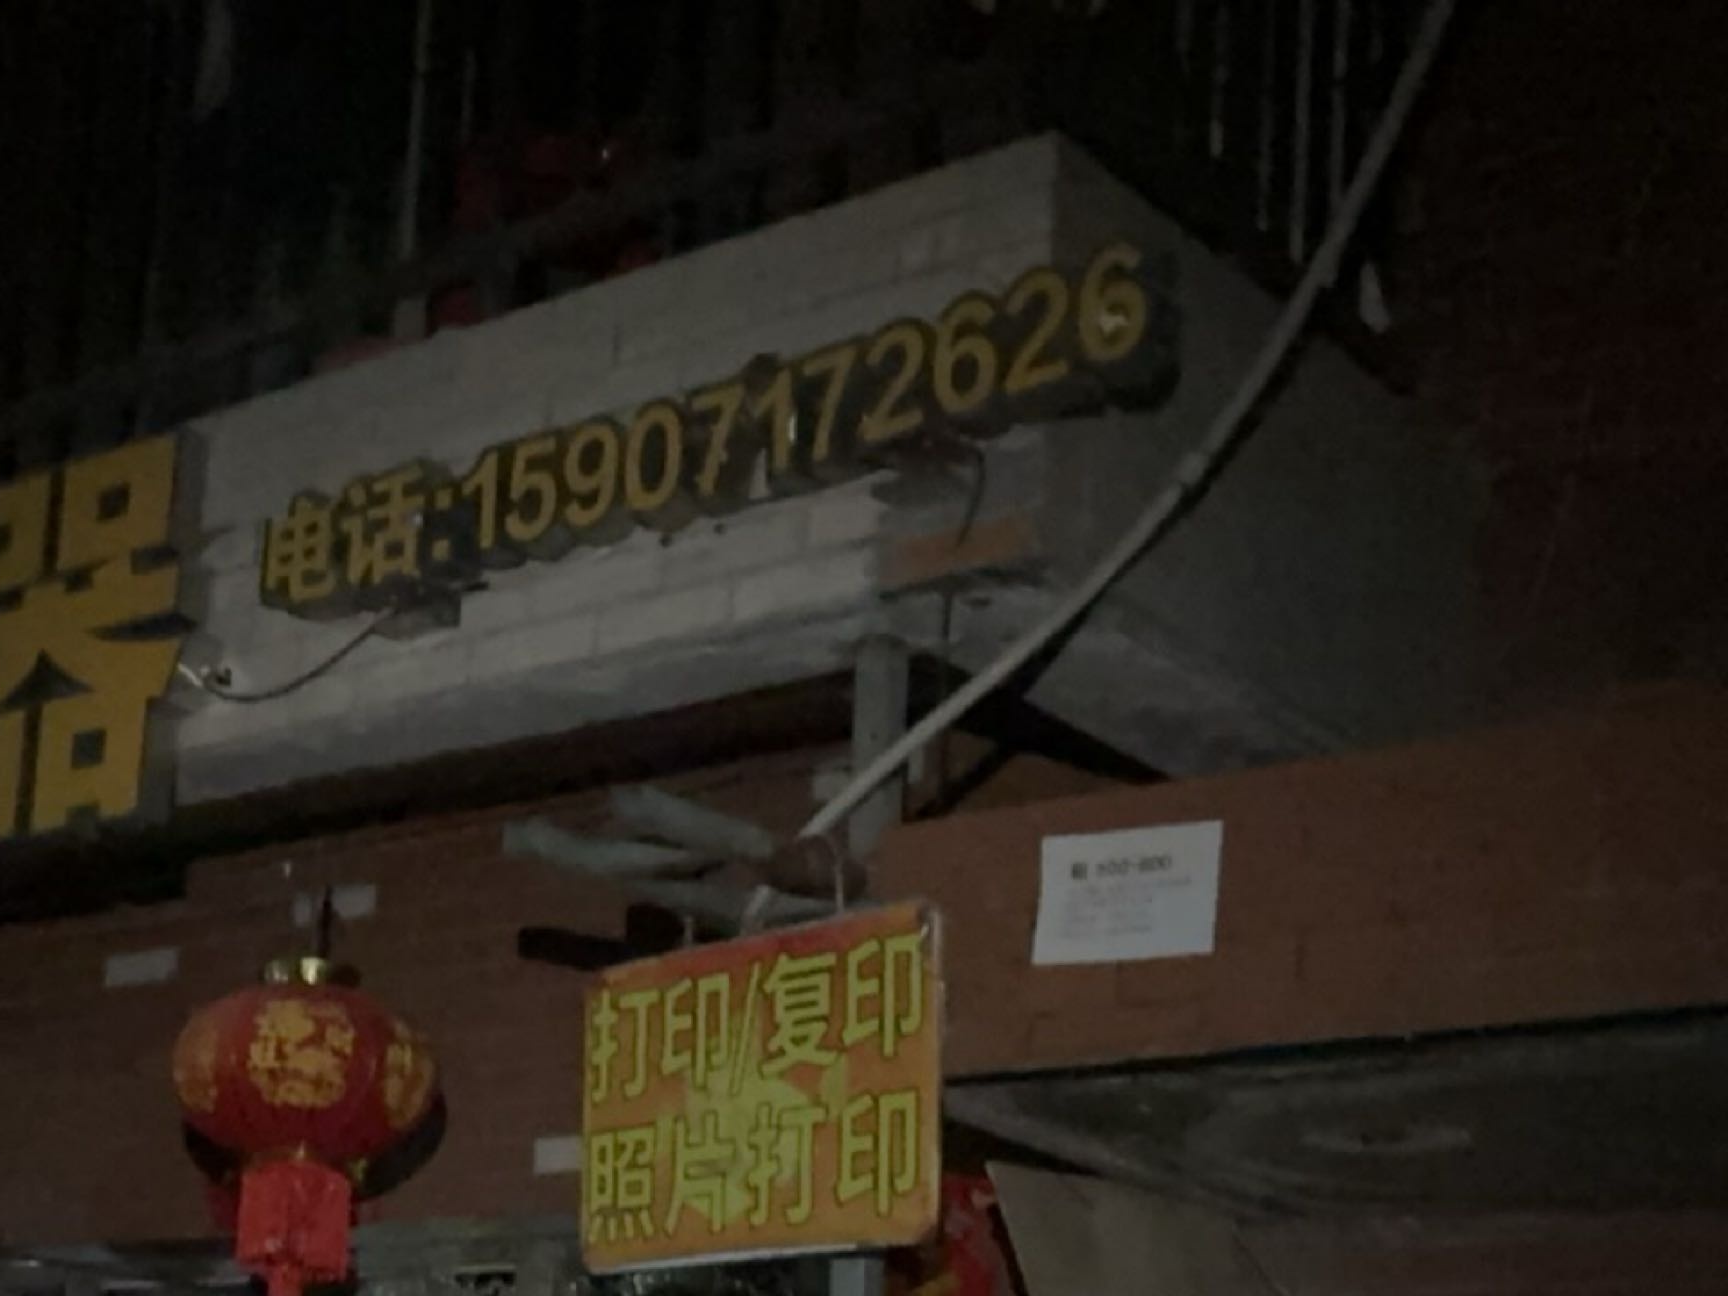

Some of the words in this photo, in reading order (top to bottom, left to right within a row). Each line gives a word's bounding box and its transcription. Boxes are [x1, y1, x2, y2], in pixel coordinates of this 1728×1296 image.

[264, 241, 1148, 604] 电话:15907172626
[589, 932, 926, 1104] 打印/复印
[589, 1090, 918, 1242] 照片打印
